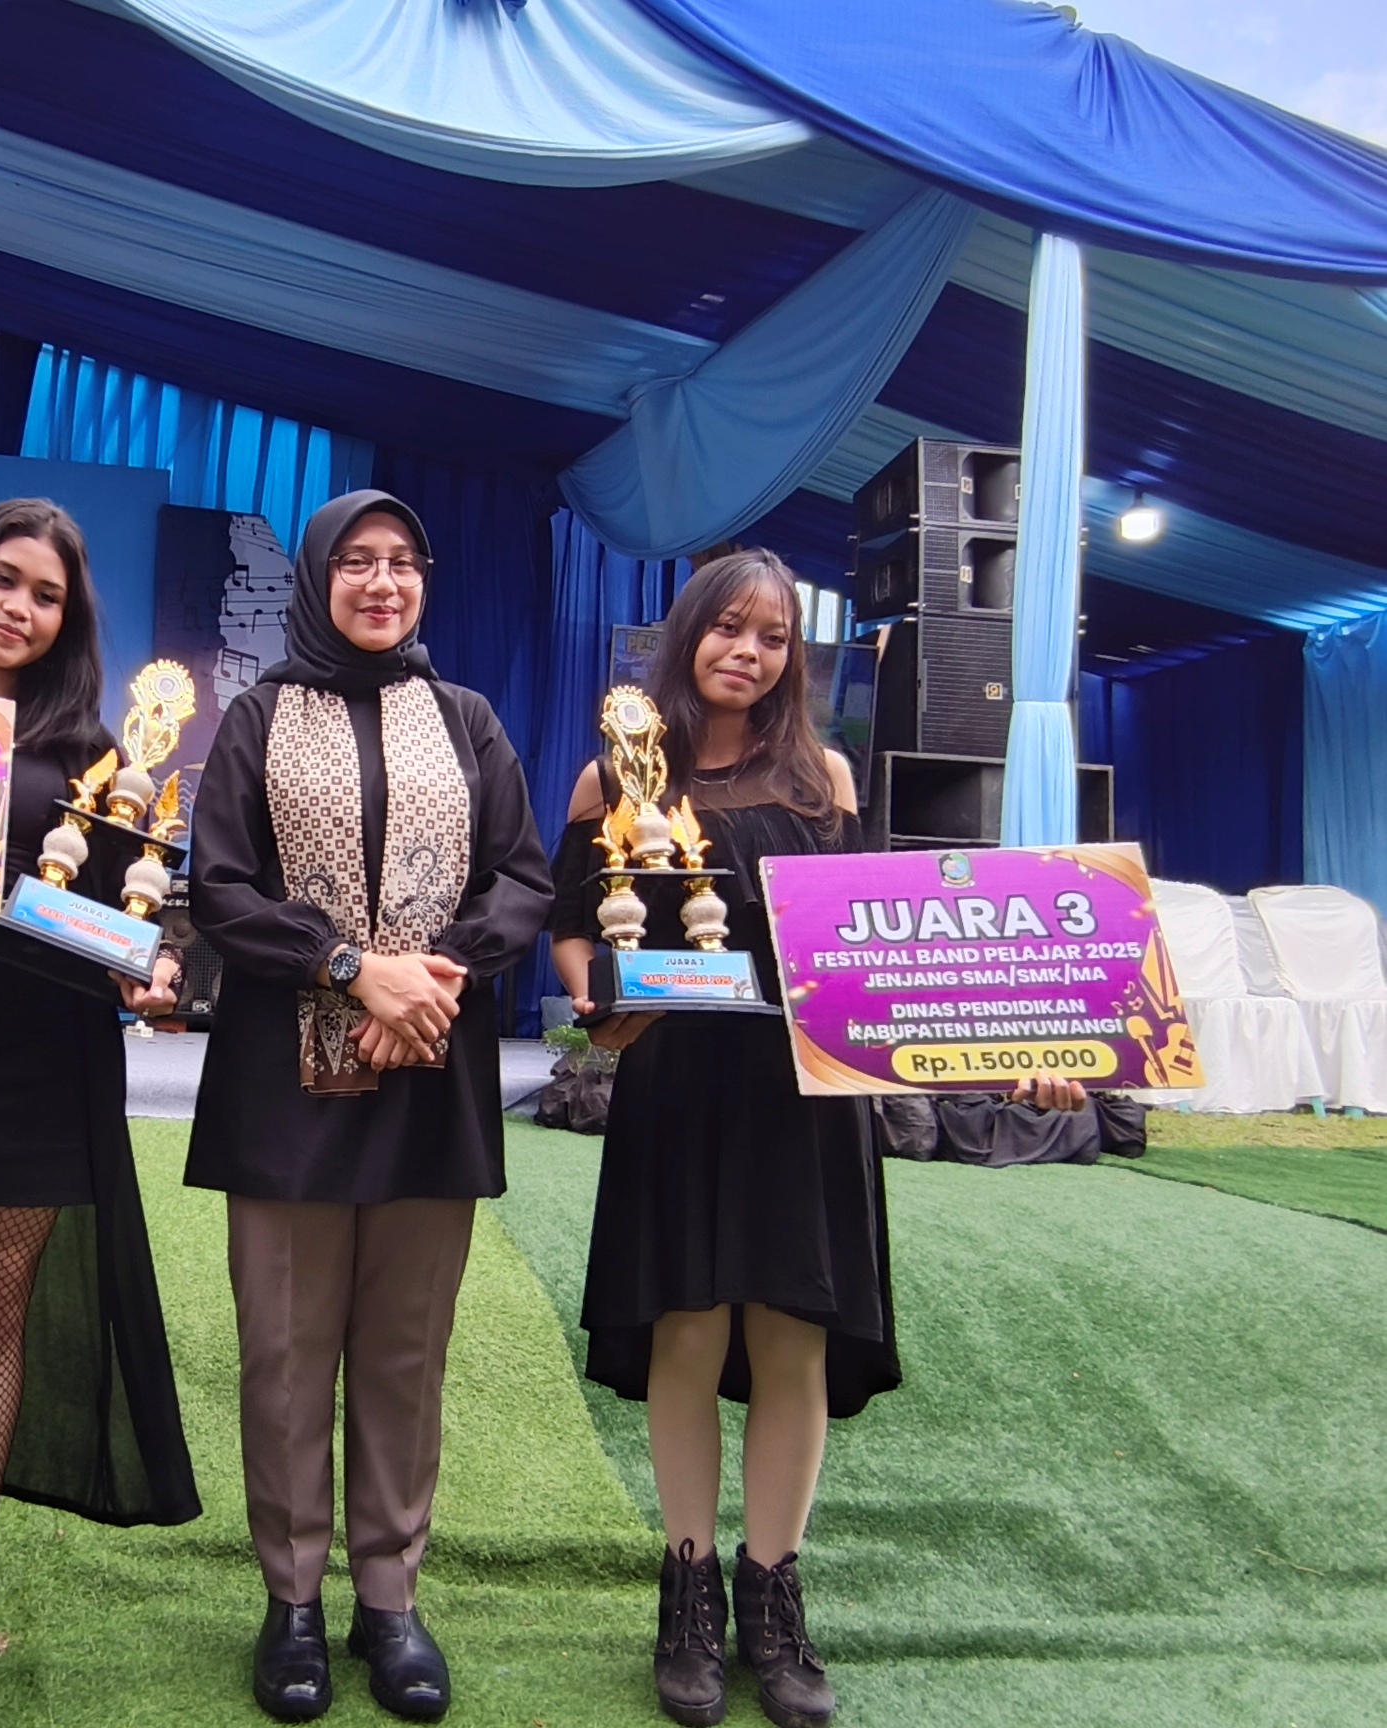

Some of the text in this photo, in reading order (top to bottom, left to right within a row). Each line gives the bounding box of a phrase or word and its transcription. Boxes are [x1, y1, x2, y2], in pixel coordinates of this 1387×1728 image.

[69, 901, 103, 918] JUARA
[836, 891, 1096, 943] JUARA 3
[665, 958, 705, 966] JUARA 3
[813, 942, 1141, 968] FESTIVAL BAND PELAJAR 2025
[641, 974, 668, 985] BAND
[864, 964, 1108, 988] JENJANG SMA/SMK/MA
[891, 999, 1086, 1019] DINAS PENDIDIKAN
[847, 1017, 1124, 1041] KABUPATEN BANYUWANGI
